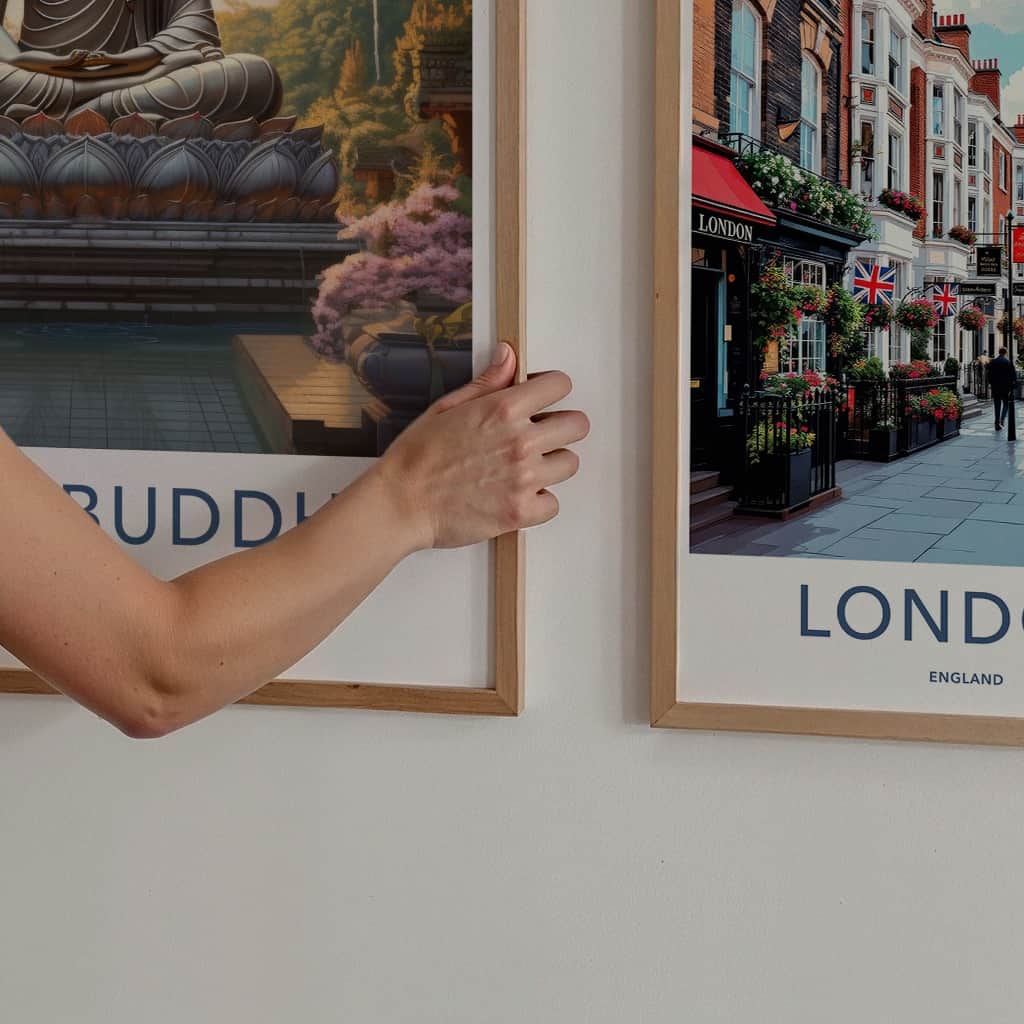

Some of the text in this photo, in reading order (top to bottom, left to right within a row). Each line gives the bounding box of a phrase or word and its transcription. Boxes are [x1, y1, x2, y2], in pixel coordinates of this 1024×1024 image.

[698, 213, 754, 242] LONDON
[800, 584, 1024, 645] LOND
[929, 671, 1004, 686] ENGLAND
